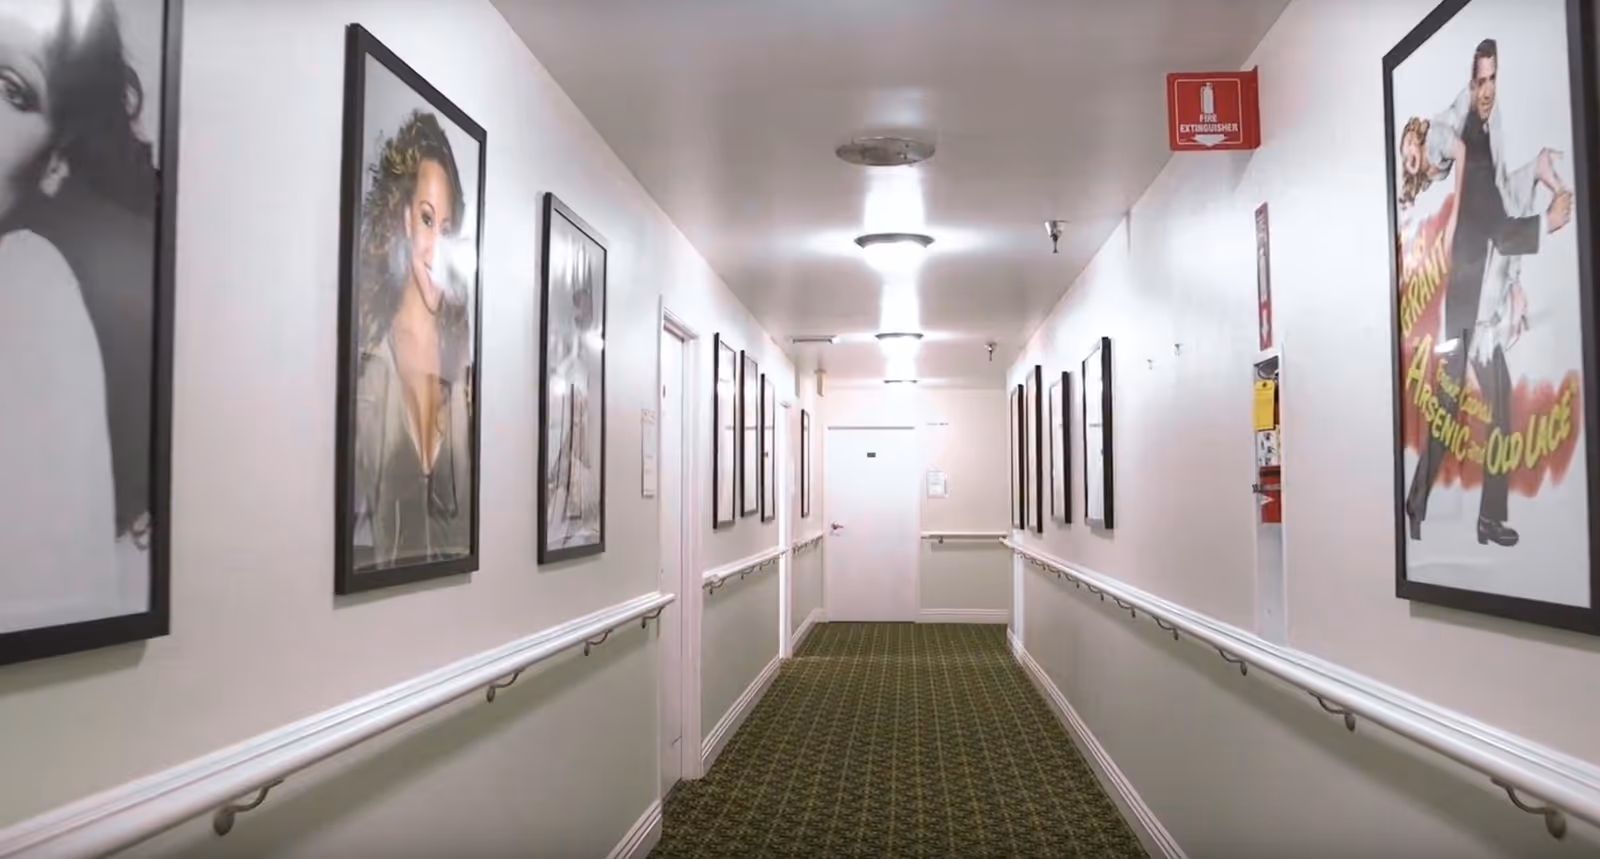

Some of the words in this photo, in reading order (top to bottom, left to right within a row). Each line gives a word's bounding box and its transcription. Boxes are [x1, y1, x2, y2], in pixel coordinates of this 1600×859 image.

[1180, 123, 1238, 132] EXTINGUISHER
[1200, 113, 1217, 122] FIRE
[1401, 230, 1449, 338] GRANT
[1406, 334, 1470, 461] ARSENIC
[1487, 426, 1522, 475] OLD
[1525, 390, 1571, 469] LACE
